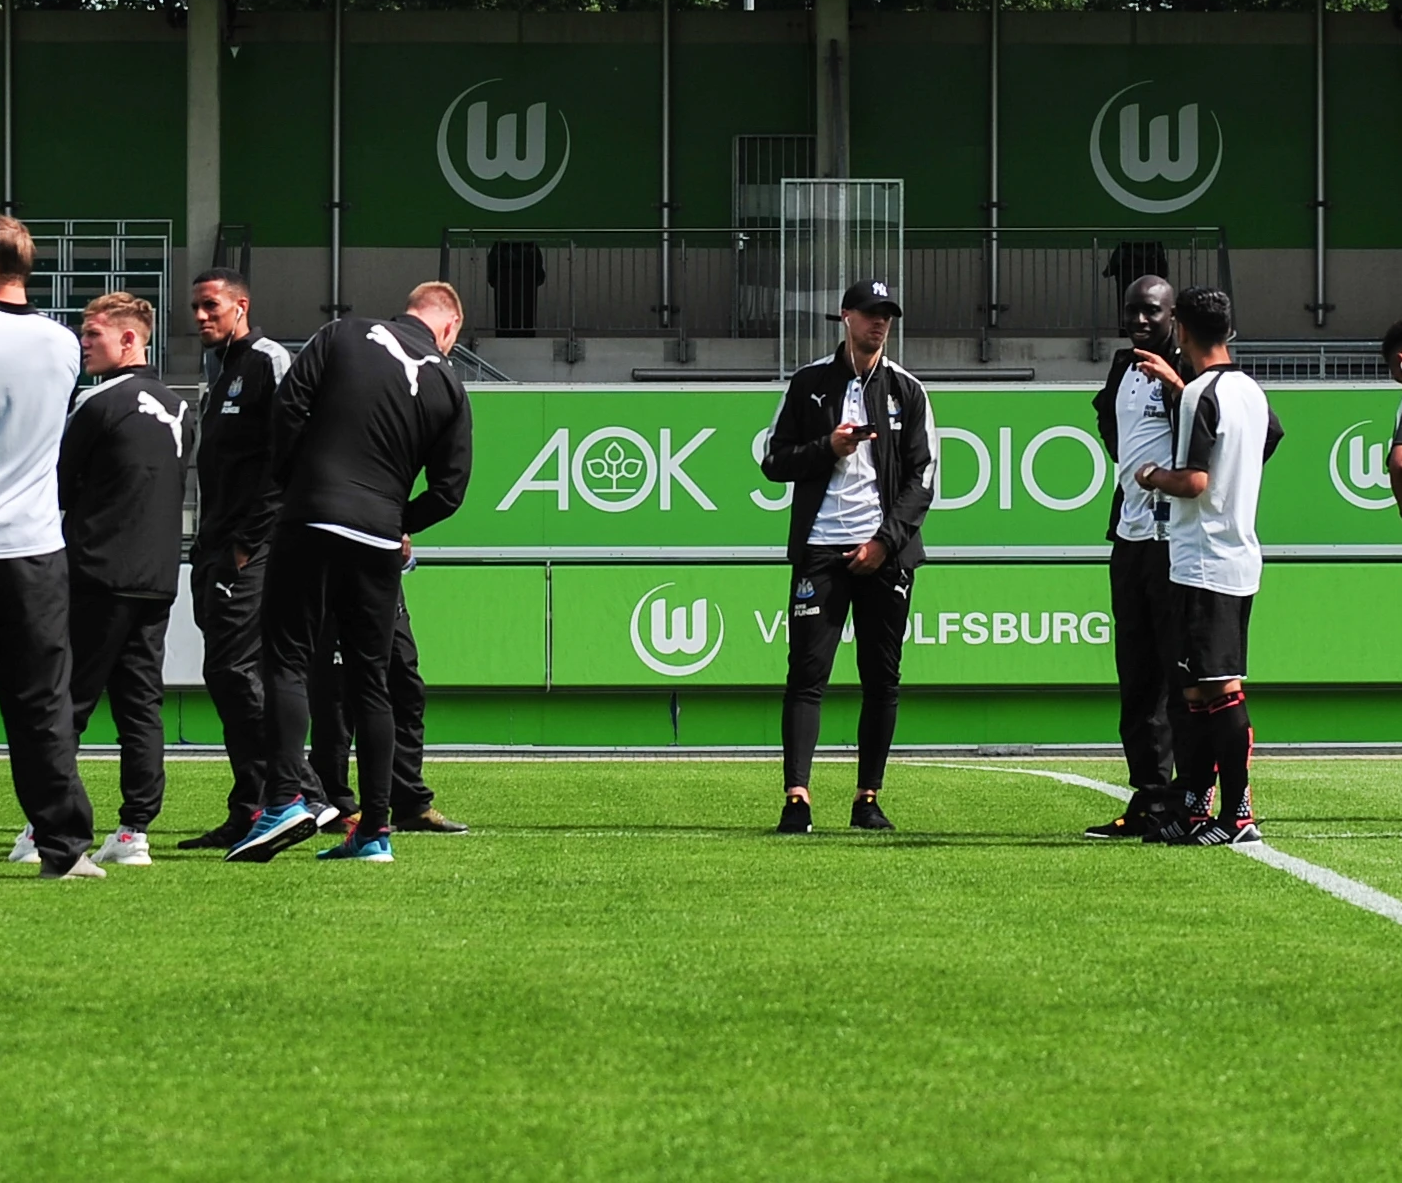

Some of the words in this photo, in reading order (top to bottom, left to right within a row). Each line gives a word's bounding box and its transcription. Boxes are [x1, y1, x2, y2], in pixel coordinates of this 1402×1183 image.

[495, 426, 718, 513] AOK
[749, 424, 1120, 511] SDIO
[841, 612, 1111, 645] LFSBURG
